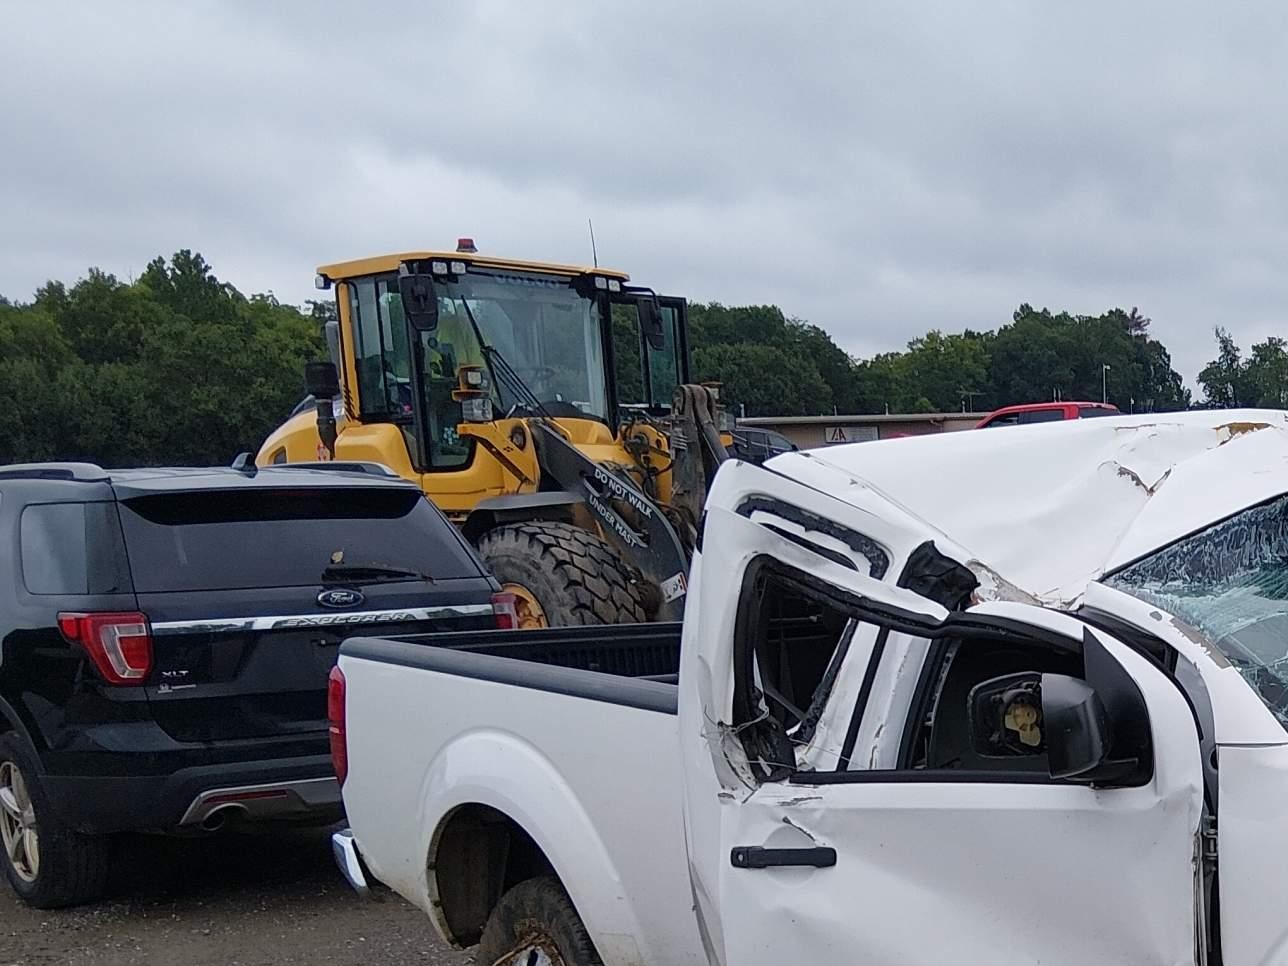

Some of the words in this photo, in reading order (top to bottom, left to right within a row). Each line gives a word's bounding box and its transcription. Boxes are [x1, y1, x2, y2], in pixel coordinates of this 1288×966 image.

[594, 468, 608, 483] DO
[608, 480, 626, 499] NOT
[628, 495, 653, 519] WALK
[589, 494, 615, 526] UNDER
[615, 523, 637, 547] MAST
